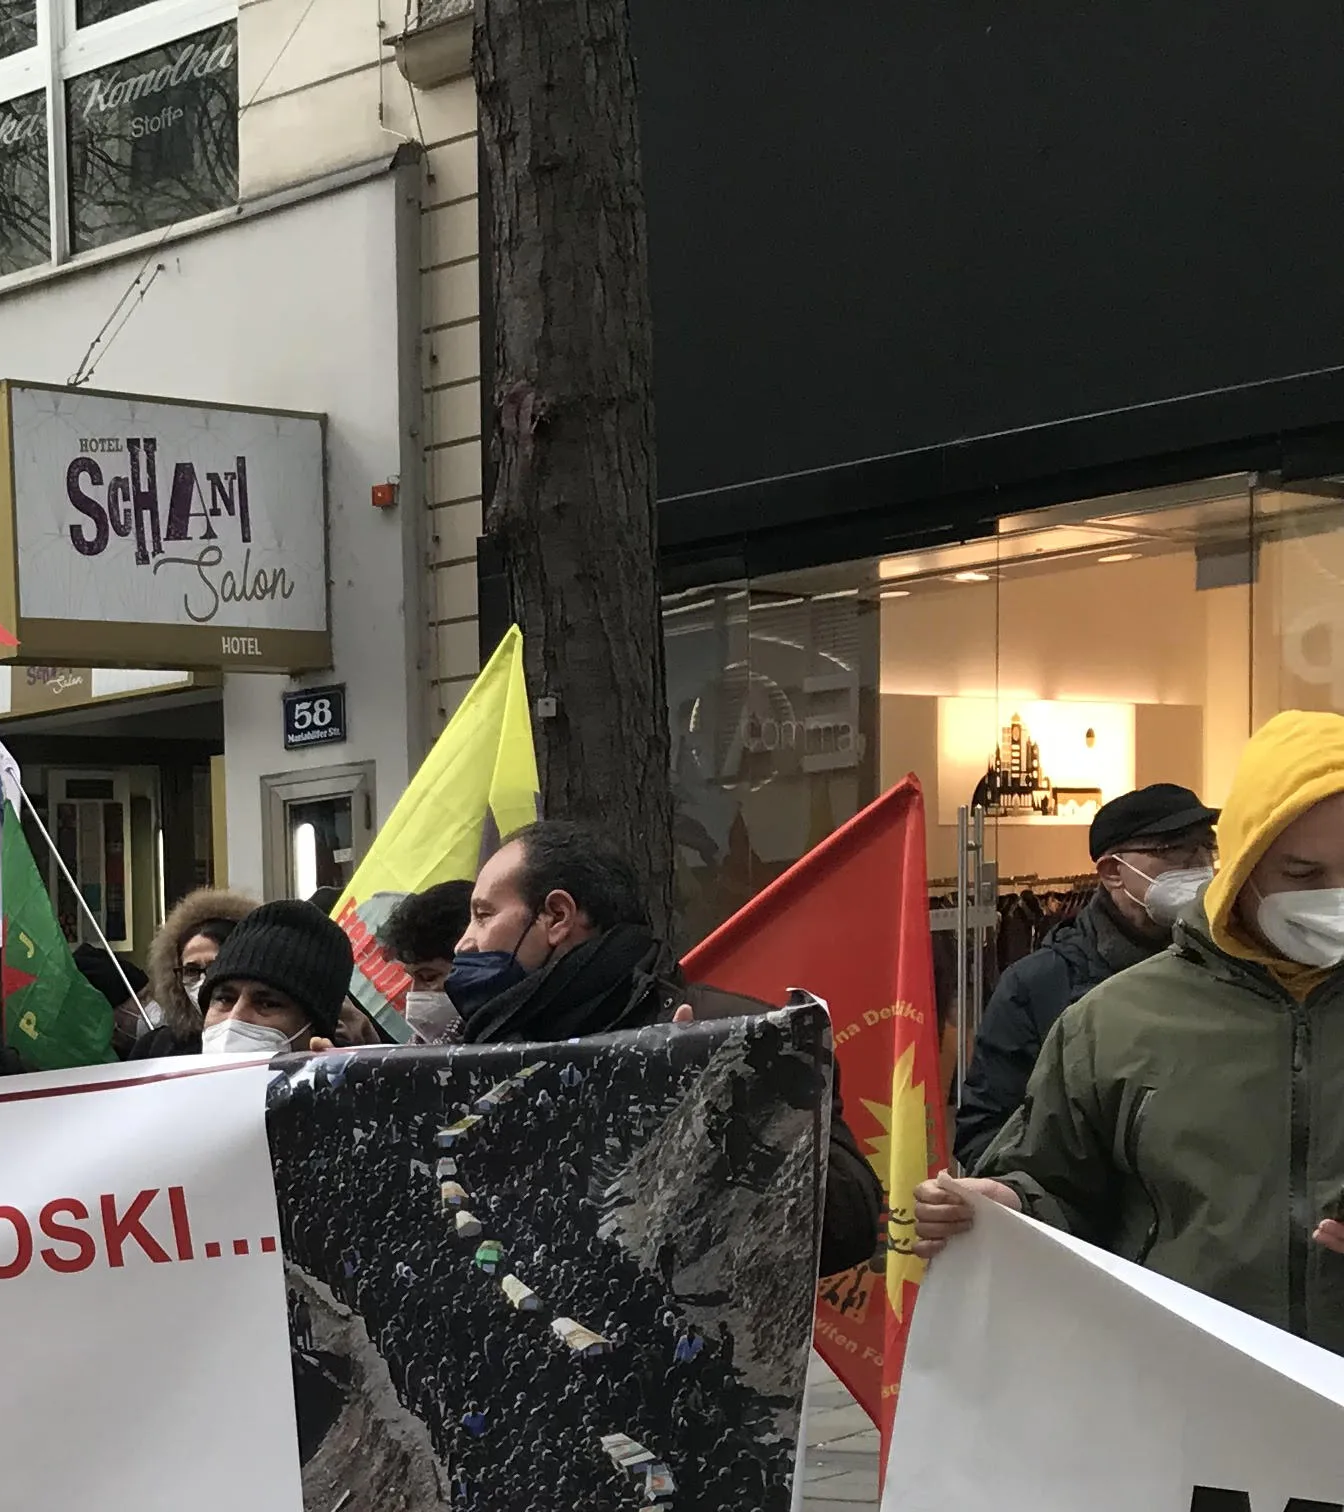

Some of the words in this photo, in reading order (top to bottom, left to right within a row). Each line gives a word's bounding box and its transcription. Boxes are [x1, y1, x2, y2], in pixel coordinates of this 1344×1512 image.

[83, 38, 233, 116] Komolka
[130, 105, 185, 138] Stoffe
[79, 437, 123, 454] HOTEL
[153, 545, 295, 623] Salon
[221, 636, 263, 658] HOTEL
[294, 699, 332, 729] 58
